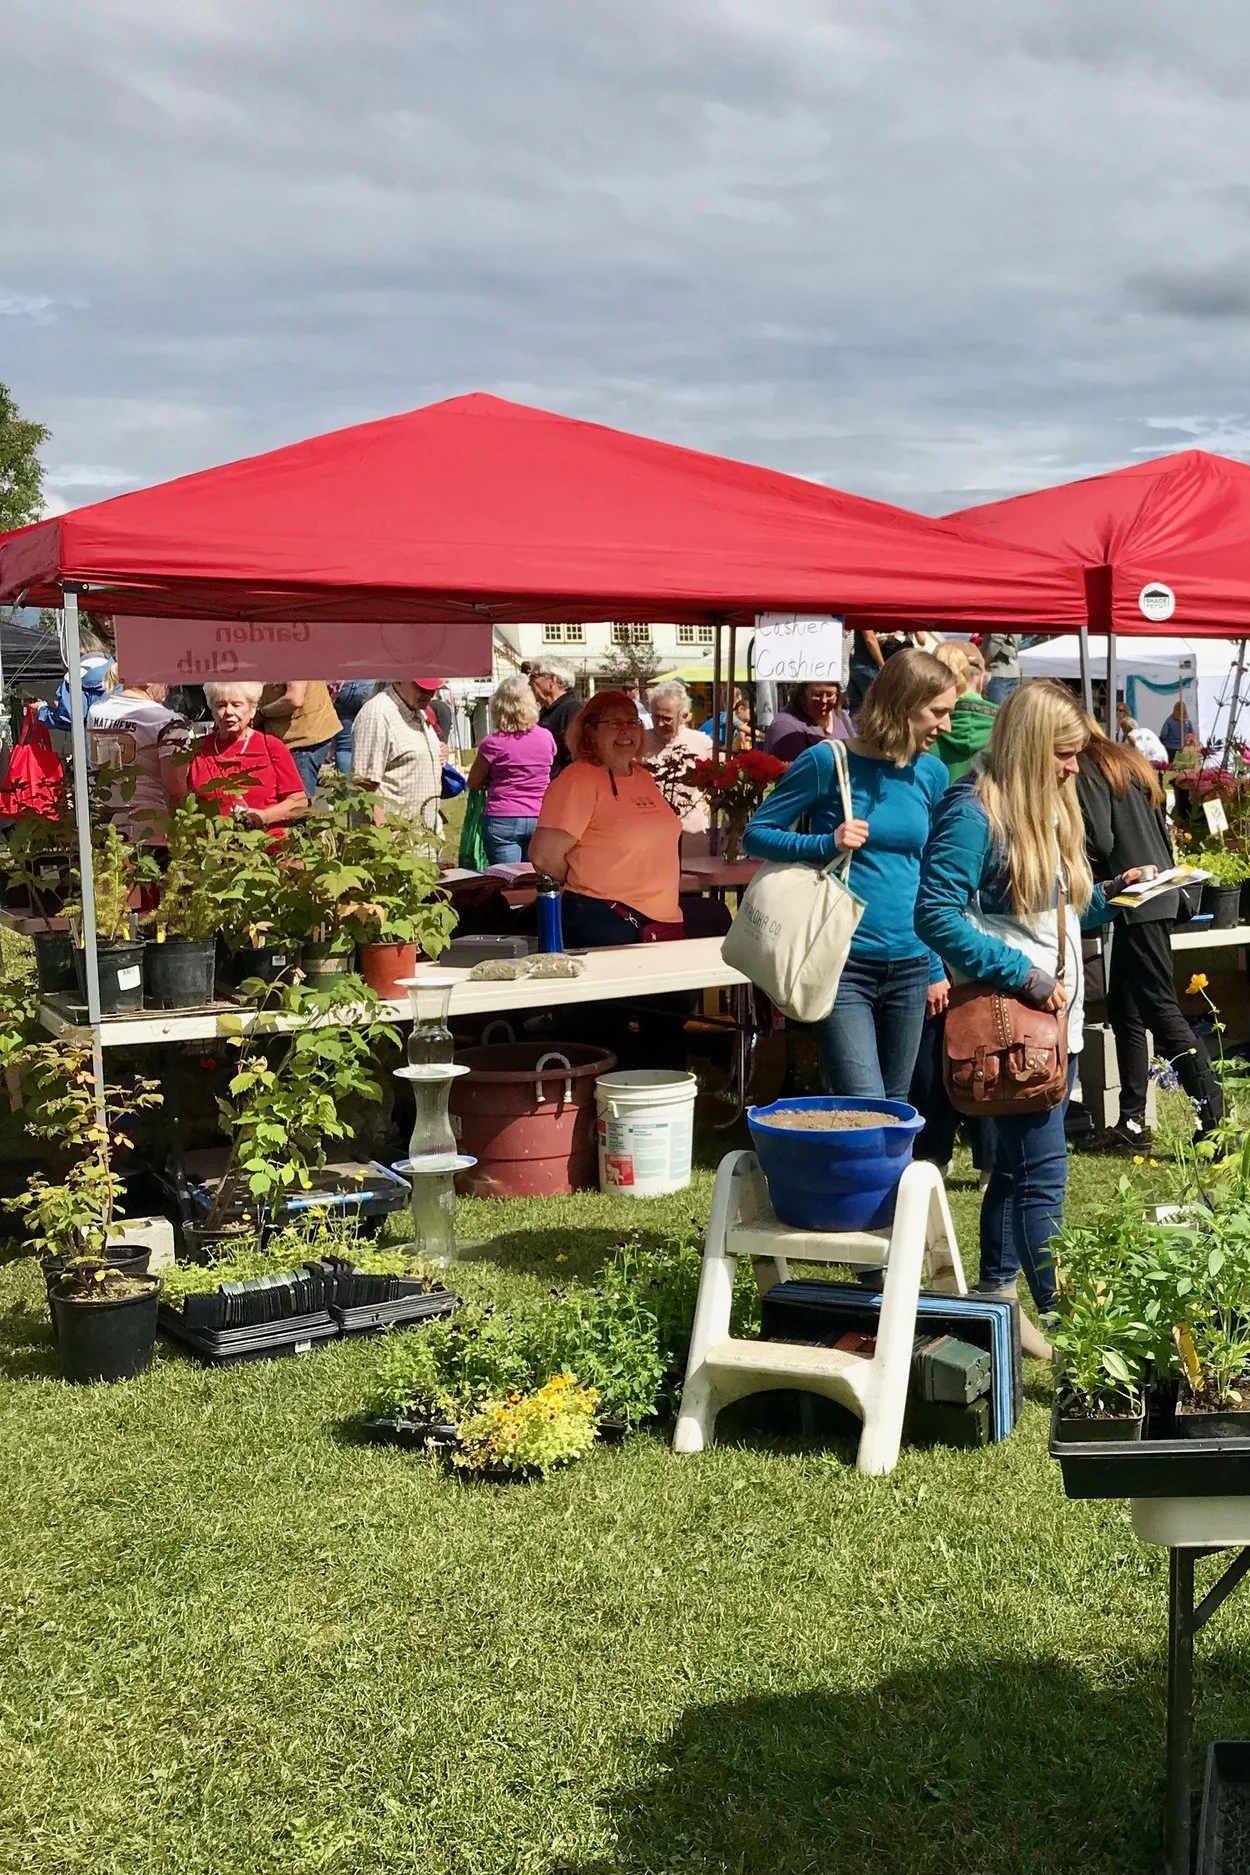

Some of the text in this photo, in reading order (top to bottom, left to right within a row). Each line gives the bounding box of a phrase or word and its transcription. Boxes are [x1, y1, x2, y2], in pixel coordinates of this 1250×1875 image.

[758, 611, 829, 637] Cashier
[757, 648, 837, 679] Cashier
[93, 717, 137, 733] MATTHEWS
